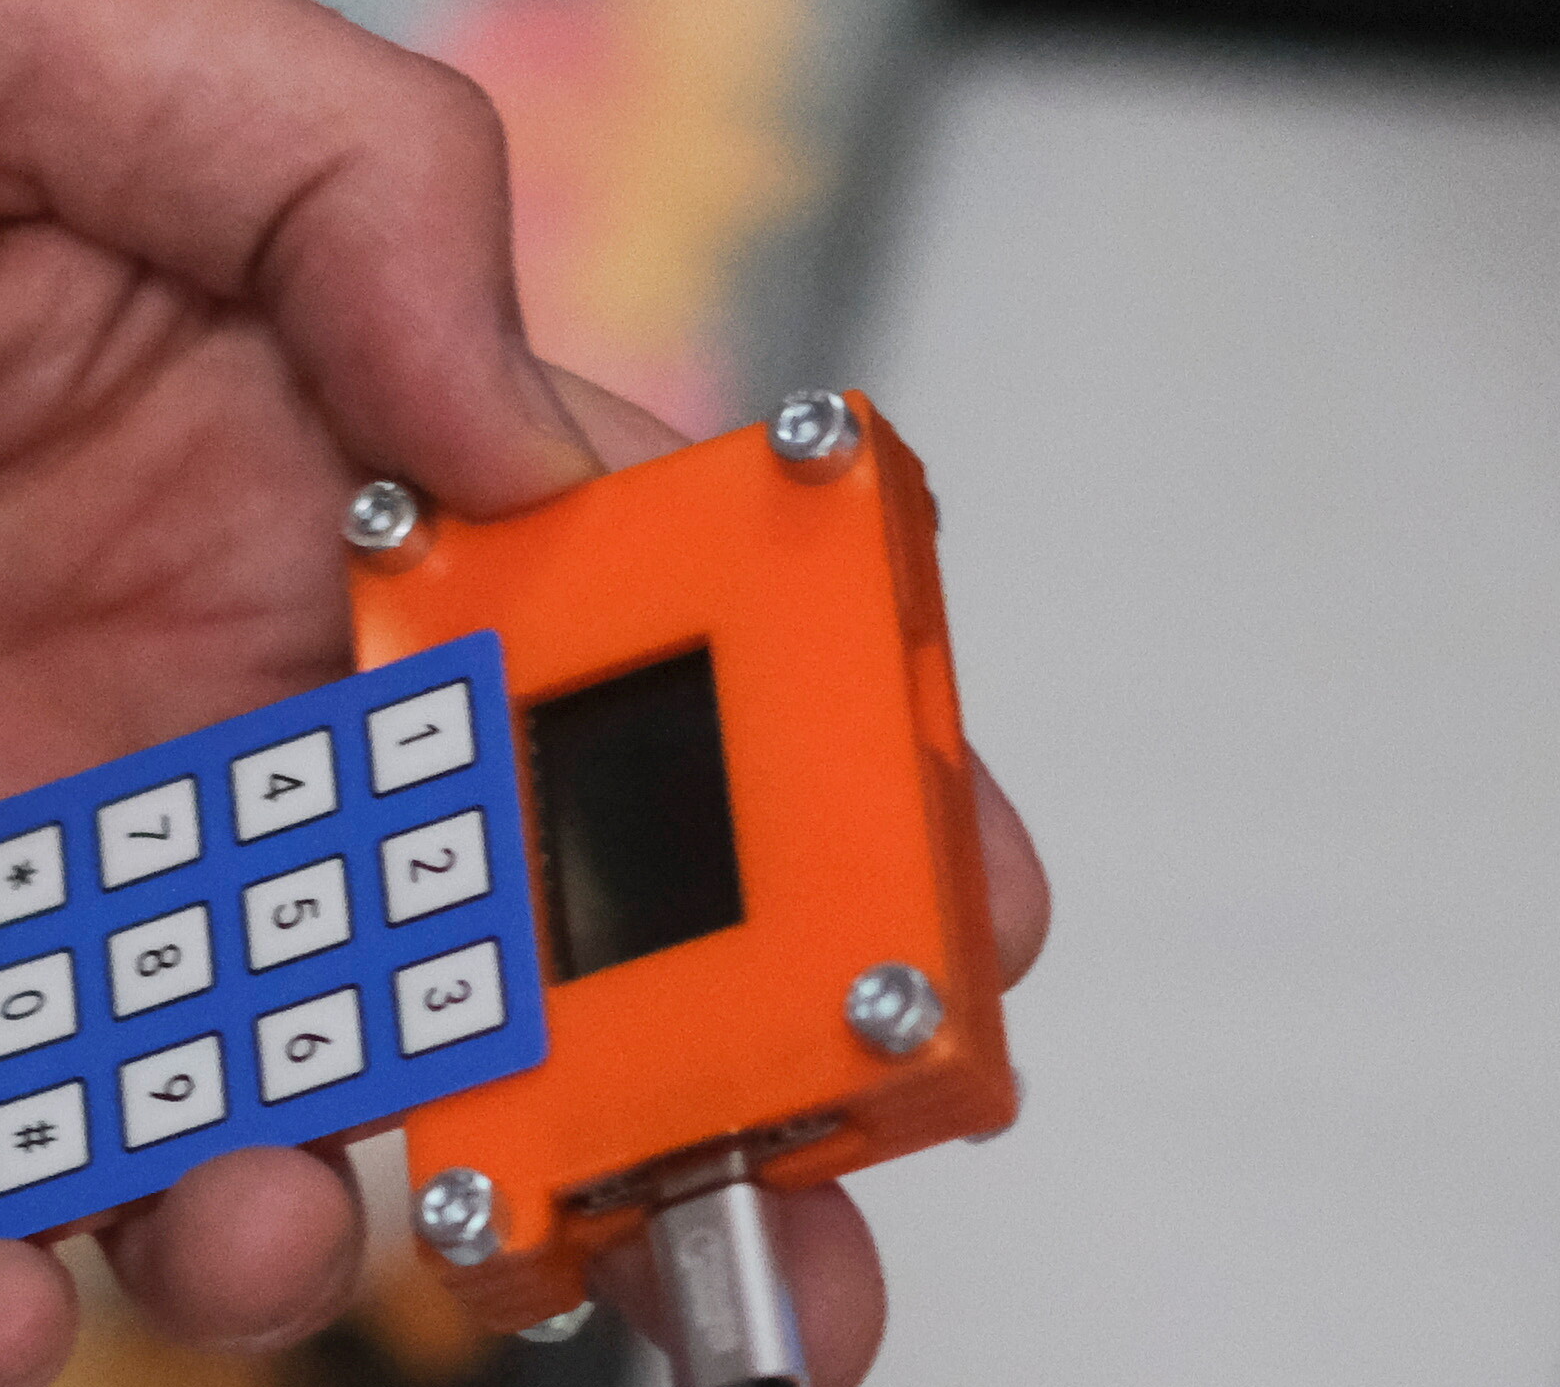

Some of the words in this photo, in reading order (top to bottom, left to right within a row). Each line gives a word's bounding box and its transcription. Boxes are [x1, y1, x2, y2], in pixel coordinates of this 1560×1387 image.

[398, 723, 442, 747] 1
[262, 772, 306, 802] 4
[126, 815, 171, 841] 7
[408, 847, 457, 884] 2
[270, 898, 320, 930] 5
[135, 943, 182, 978] 8
[0, 989, 47, 1021] 0
[423, 979, 473, 1013] 3
[284, 1032, 333, 1064] 6
[148, 1073, 197, 1103] 9
[13, 1120, 59, 1154] #
